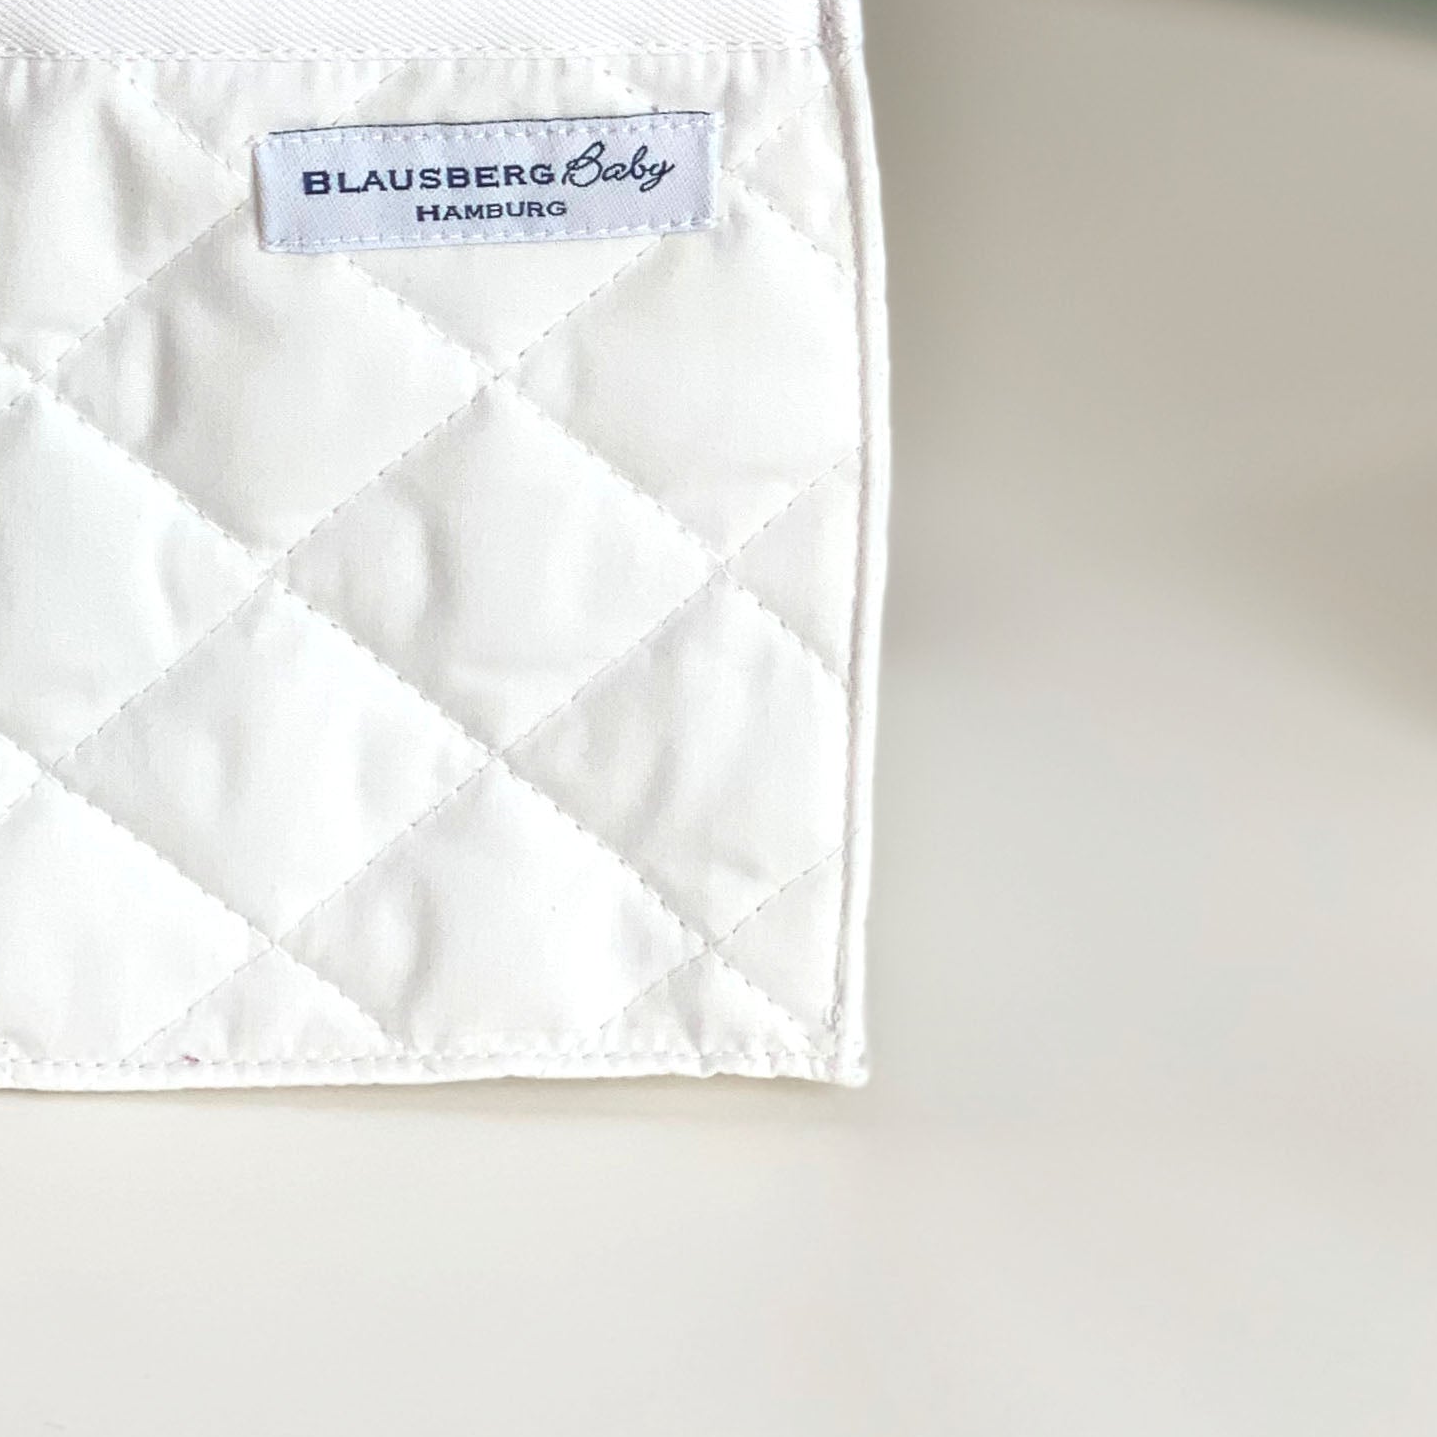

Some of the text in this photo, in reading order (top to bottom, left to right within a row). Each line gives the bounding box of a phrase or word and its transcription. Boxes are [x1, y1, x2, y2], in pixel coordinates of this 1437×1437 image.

[302, 140, 676, 196] BLAUSBERG Baby
[415, 200, 568, 223] HAMBURG
